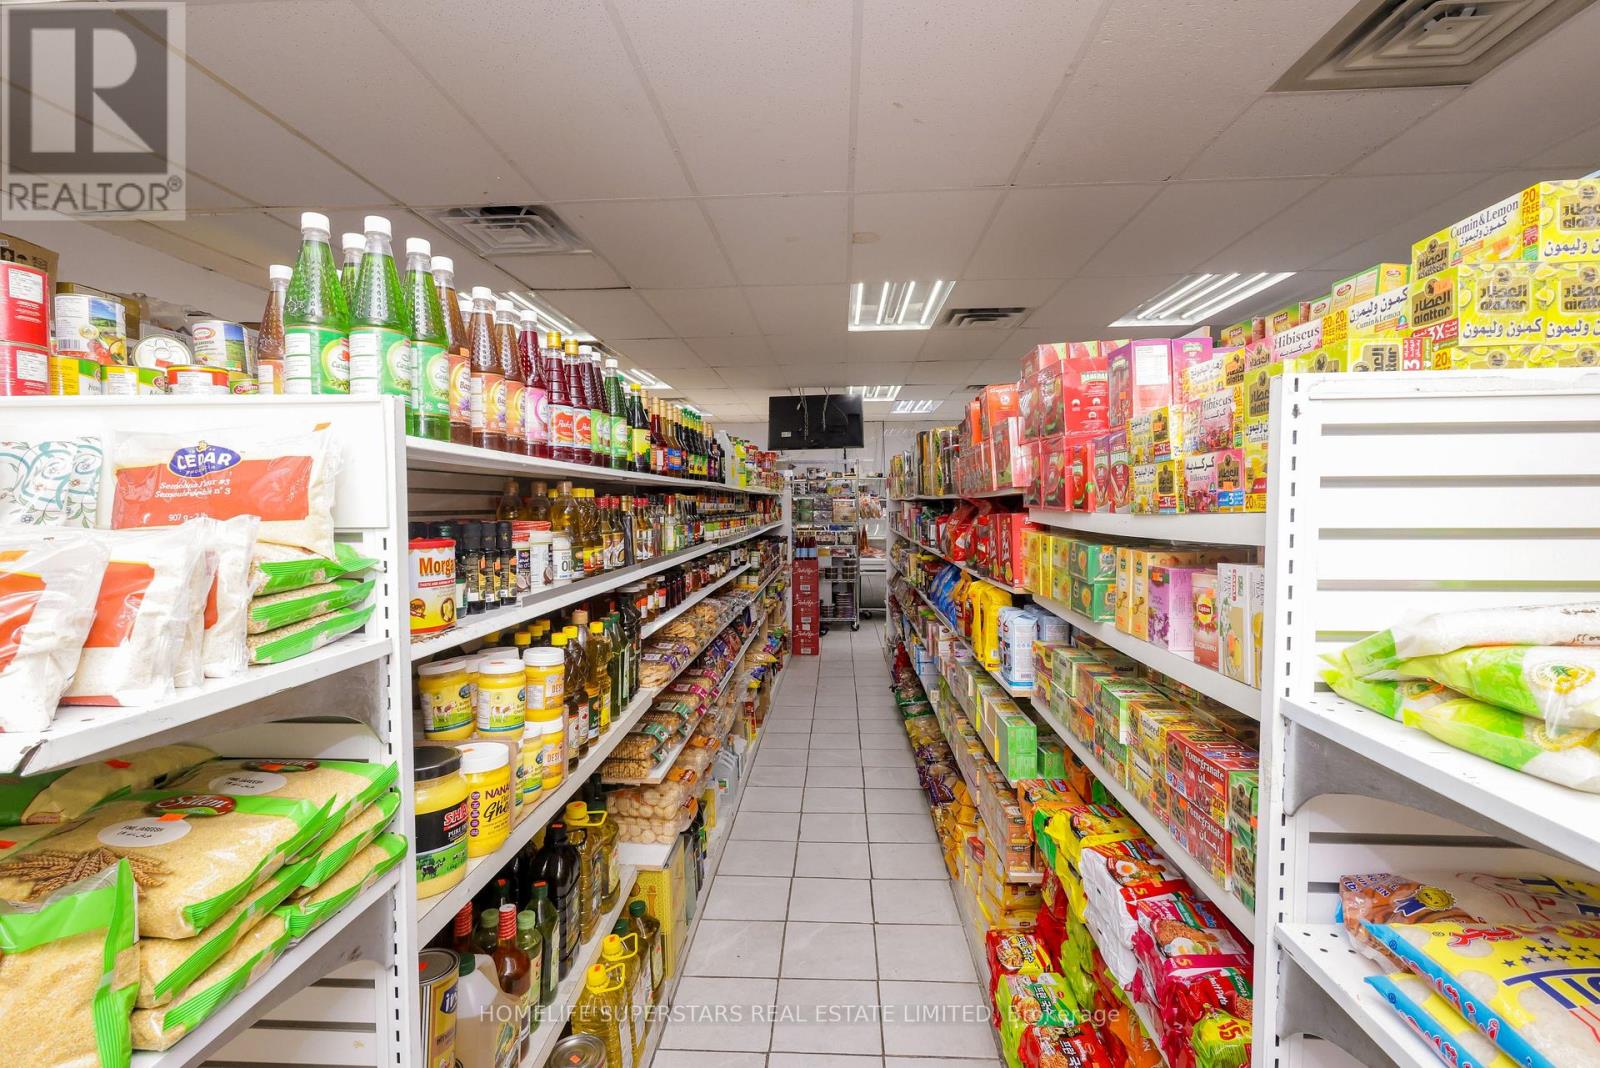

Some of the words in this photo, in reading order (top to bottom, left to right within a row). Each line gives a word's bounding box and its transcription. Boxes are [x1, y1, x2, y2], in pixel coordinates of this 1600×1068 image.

[1522, 201, 1540, 215] FREE
[1450, 200, 1519, 239] Cumin&Lemon
[1414, 290, 1452, 314] العطار
[1413, 305, 1451, 326] alattar
[1463, 320, 1504, 339] وليمون
[1506, 317, 1542, 338] كمون
[177, 451, 233, 470] CEDAR
[1185, 746, 1225, 782] Pomegranate
[1187, 800, 1225, 842] Pomegranate
